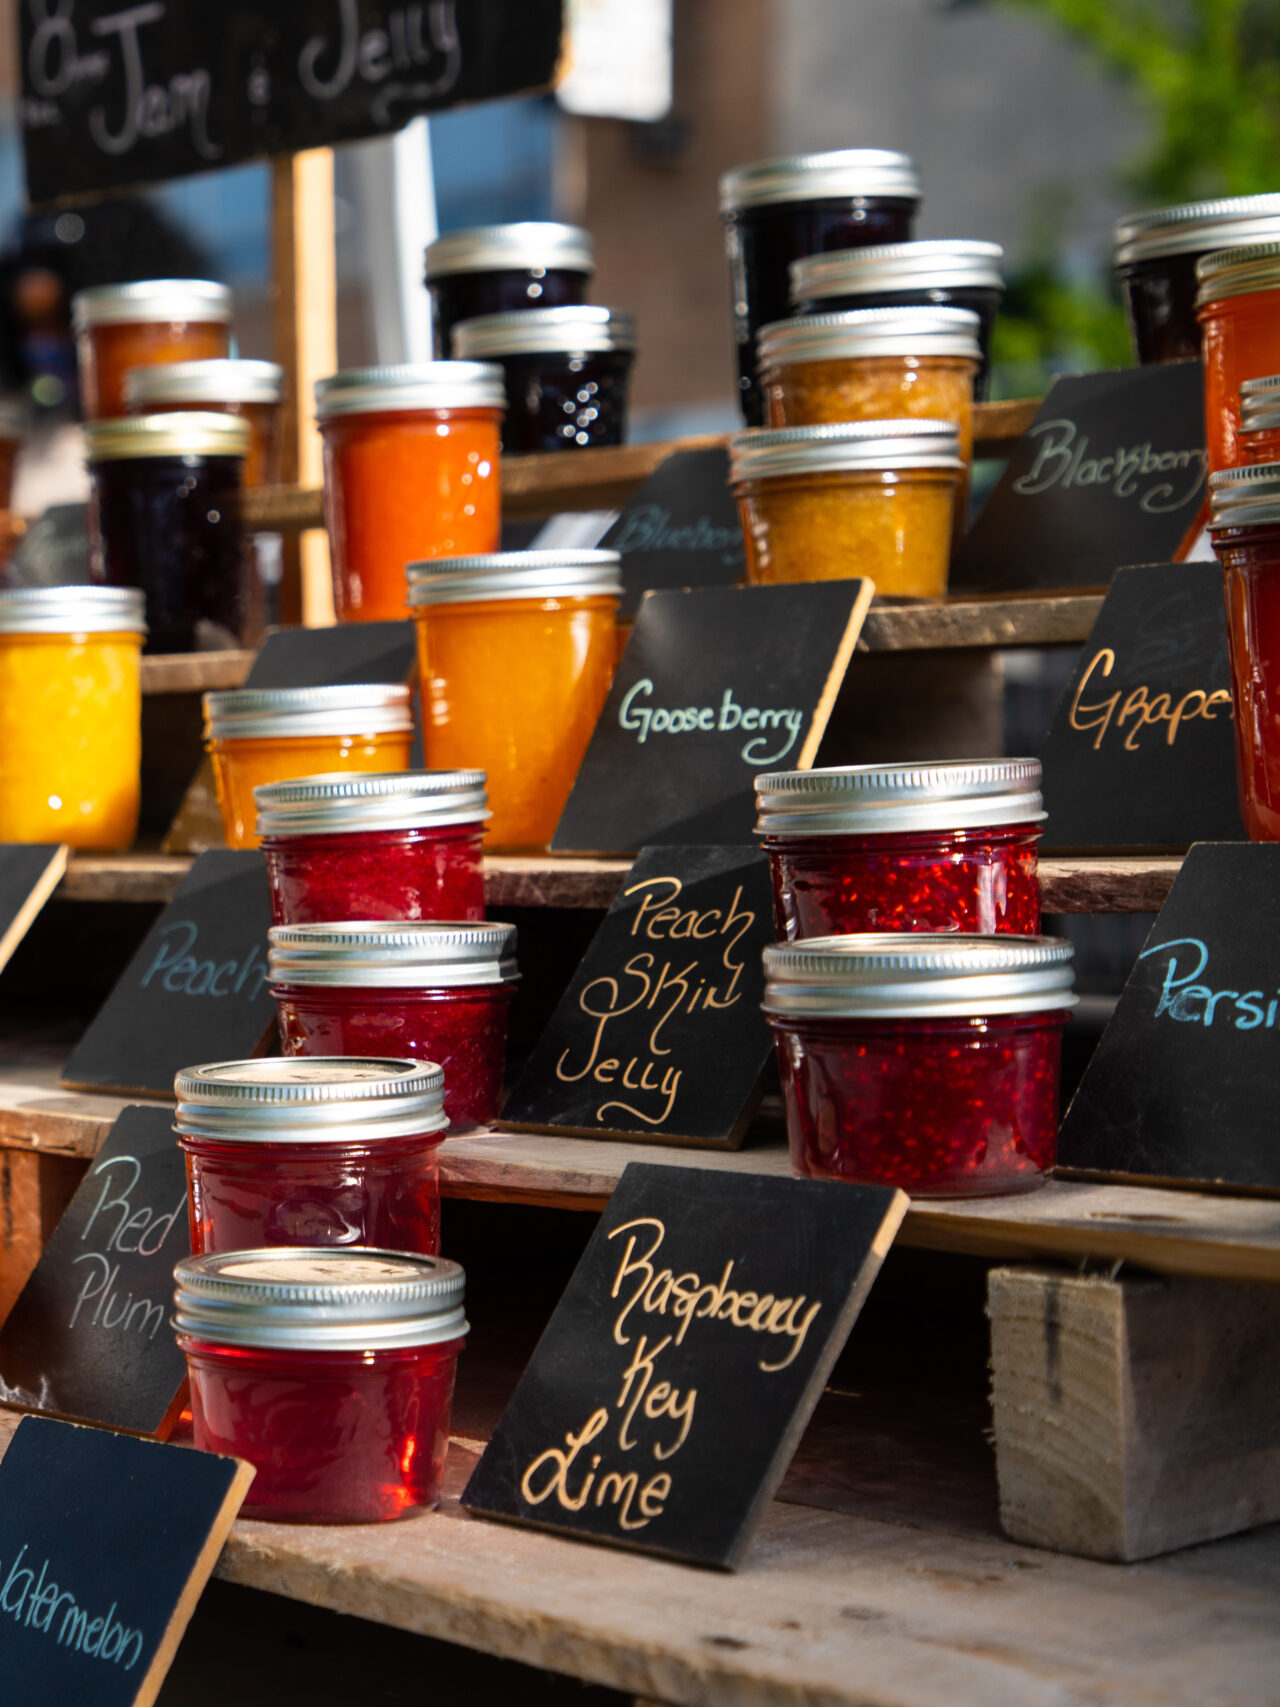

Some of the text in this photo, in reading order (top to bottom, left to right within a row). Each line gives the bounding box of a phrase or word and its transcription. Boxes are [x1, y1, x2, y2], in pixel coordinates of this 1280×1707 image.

[90, 2, 223, 160] Jam
[1013, 419, 1209, 513] Blackberry
[619, 678, 802, 765] Gooseberry
[1070, 649, 1234, 750] Grape
[141, 920, 267, 1000] Peach
[624, 877, 755, 970] Peach
[556, 1012, 682, 1125] Jelly
[81, 1155, 188, 1256] Red
[69, 1253, 165, 1340] Plum
[608, 1217, 822, 1372] Raspberry
[617, 1335, 698, 1460] Key
[521, 1408, 673, 1530] Lime
